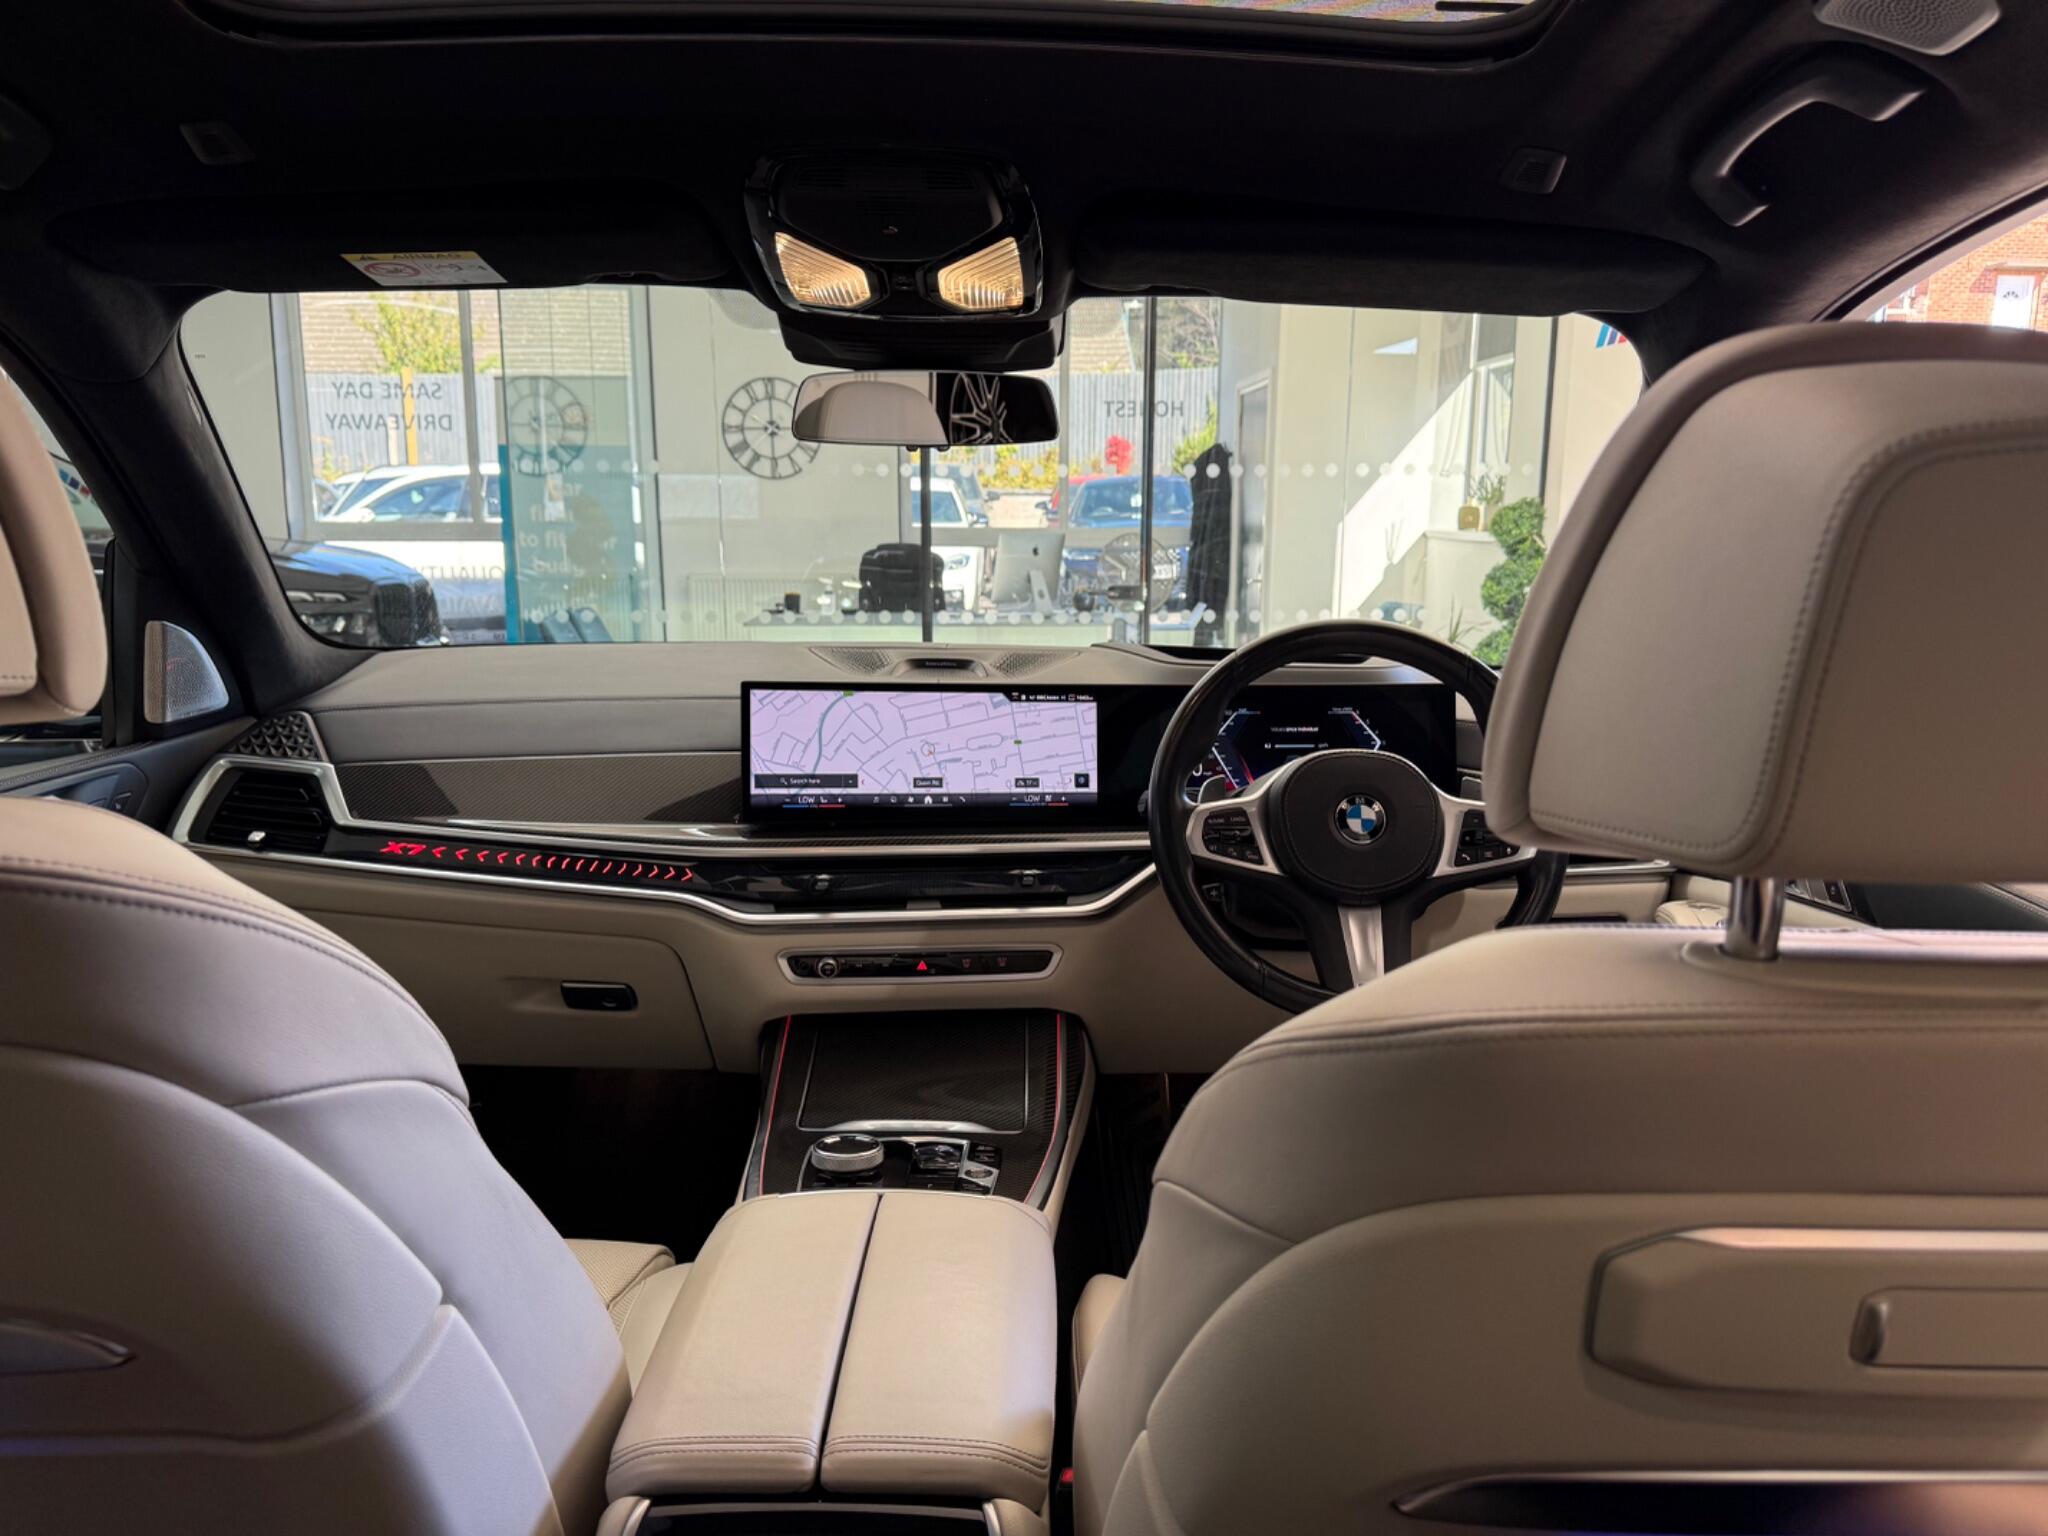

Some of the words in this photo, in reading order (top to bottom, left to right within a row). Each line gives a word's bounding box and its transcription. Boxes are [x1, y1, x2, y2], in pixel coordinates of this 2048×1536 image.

[798, 795, 816, 804] LOW
[1024, 794, 1041, 803] LOW
[379, 841, 427, 856] X7
